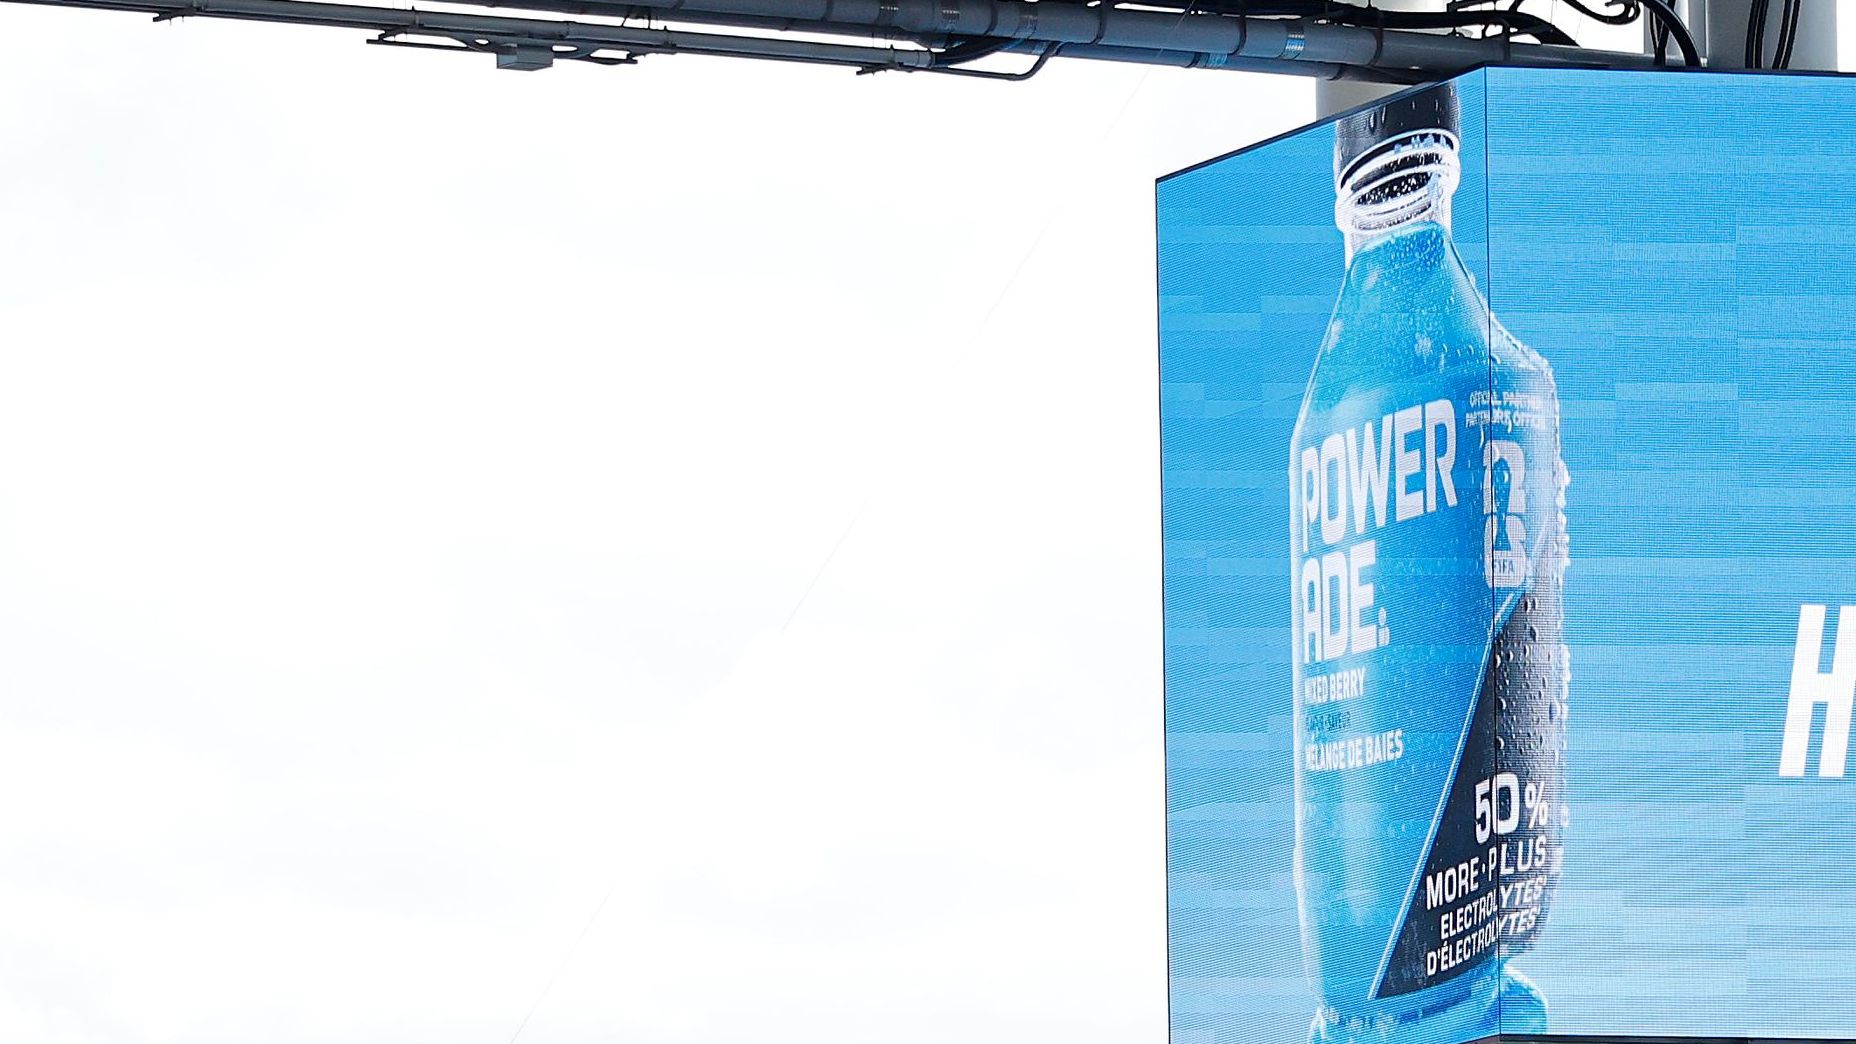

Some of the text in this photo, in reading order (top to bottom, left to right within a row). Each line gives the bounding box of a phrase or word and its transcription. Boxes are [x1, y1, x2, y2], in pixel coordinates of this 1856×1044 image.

[1301, 398, 1458, 554] POWER
[1329, 666, 1367, 700] BERRY
[1348, 735, 1364, 767] DE
[1366, 729, 1404, 765] BAIES
